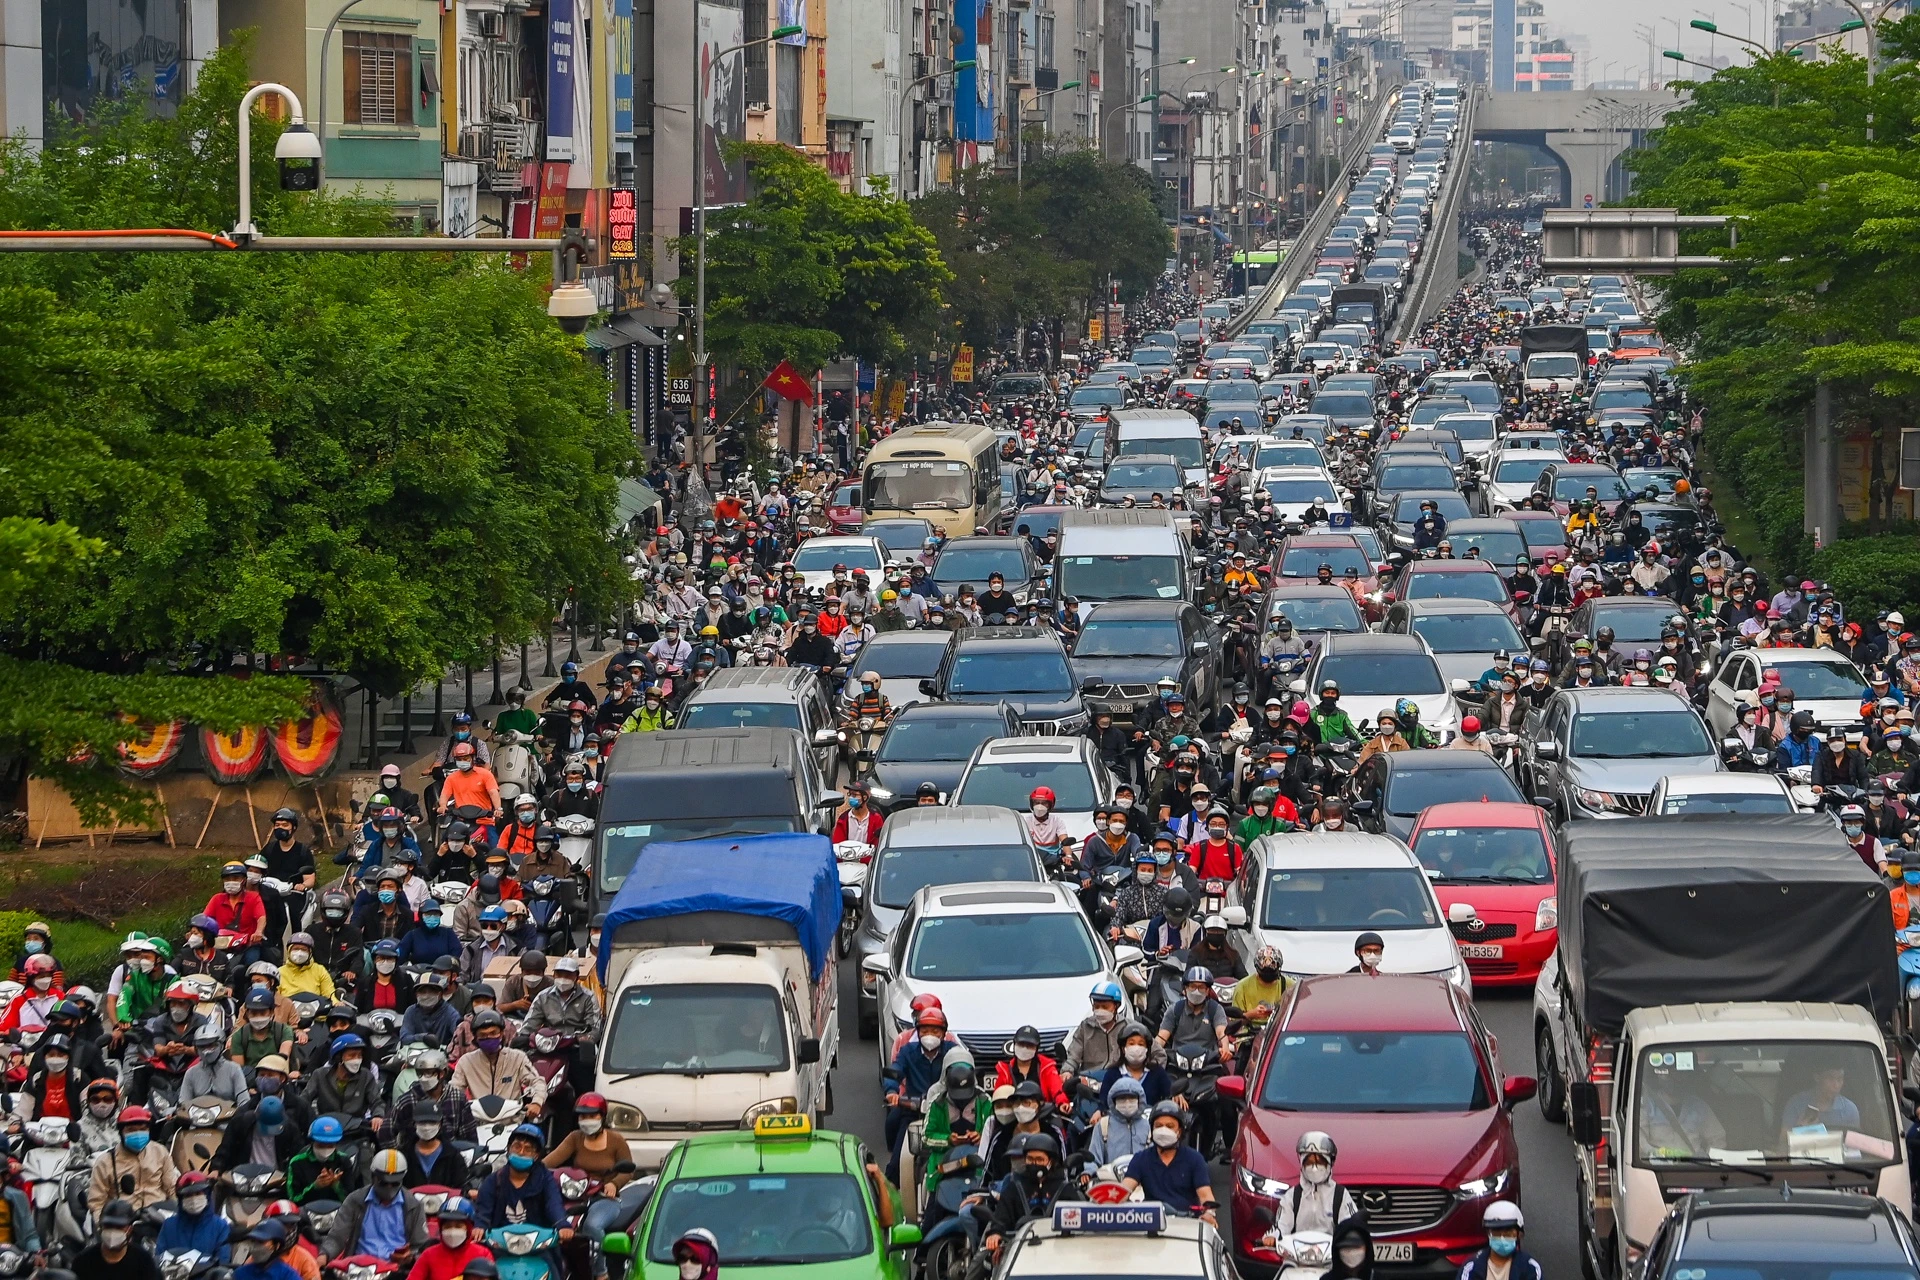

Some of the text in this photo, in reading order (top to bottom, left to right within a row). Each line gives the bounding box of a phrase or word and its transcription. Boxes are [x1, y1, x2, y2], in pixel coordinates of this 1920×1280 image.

[613, 191, 632, 207] XÔI
[613, 225, 632, 239] CAY
[612, 240, 633, 251] 628
[673, 380, 689, 390] 636
[671, 394, 692, 404] 630A
[763, 1116, 799, 1128] TAXI
[1088, 1210, 1114, 1223] PHÙ
[1376, 1246, 1410, 1260] 77.46
